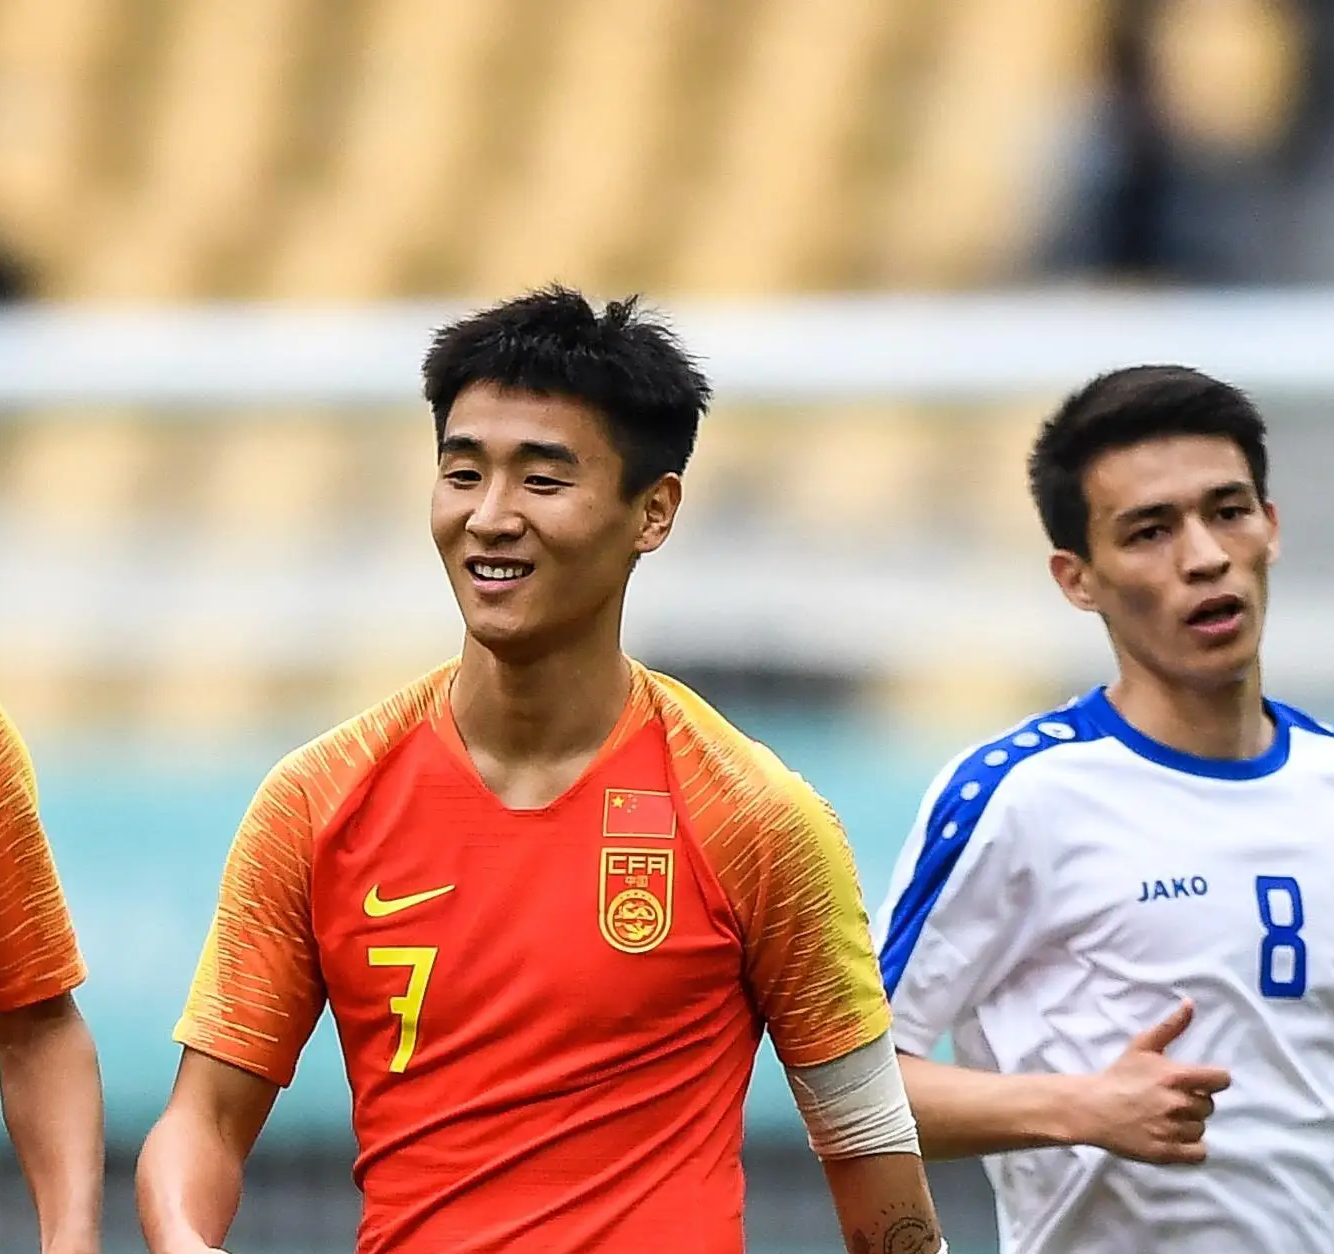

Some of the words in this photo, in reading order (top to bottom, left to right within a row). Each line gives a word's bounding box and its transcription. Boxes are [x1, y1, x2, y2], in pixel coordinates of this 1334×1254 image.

[608, 855, 666, 876] CFA
[1137, 876, 1208, 901] JAKO
[1256, 875, 1307, 998] 8
[367, 947, 438, 1073] 7
